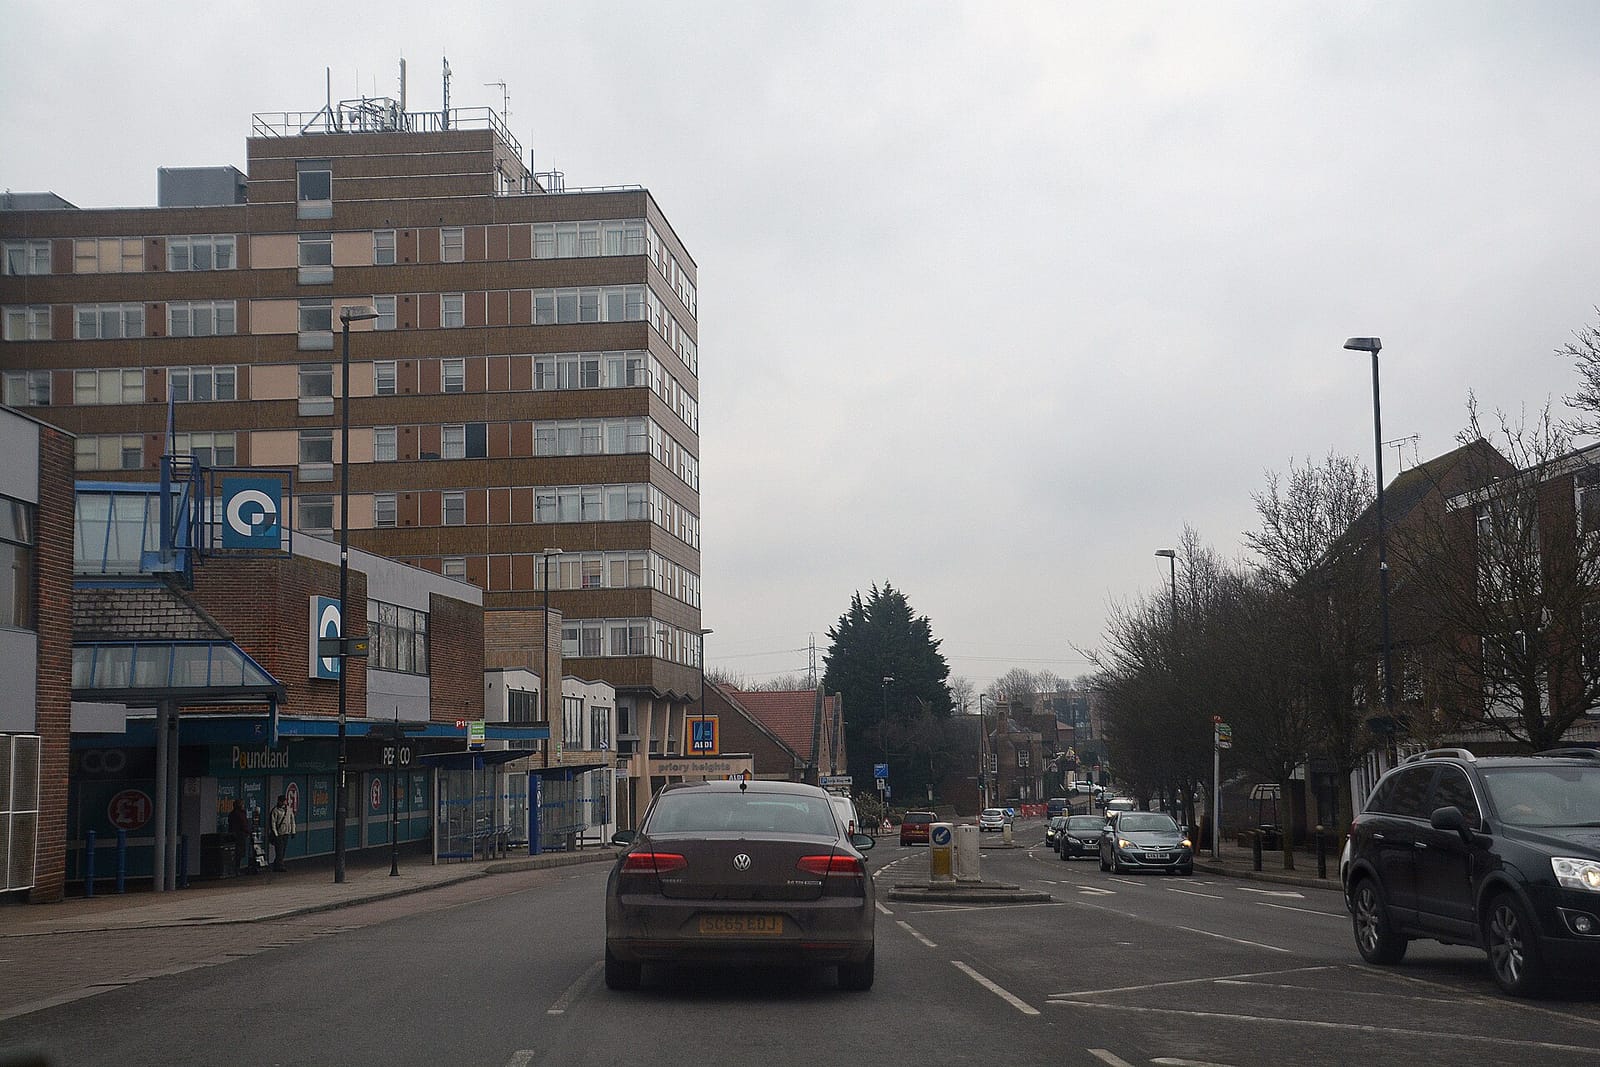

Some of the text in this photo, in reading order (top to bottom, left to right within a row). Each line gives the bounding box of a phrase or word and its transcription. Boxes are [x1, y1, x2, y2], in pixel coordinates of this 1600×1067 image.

[694, 741, 713, 749] ALDI
[232, 745, 289, 769] Poundland
[691, 761, 731, 773] heights
[116, 797, 146, 824] £1
